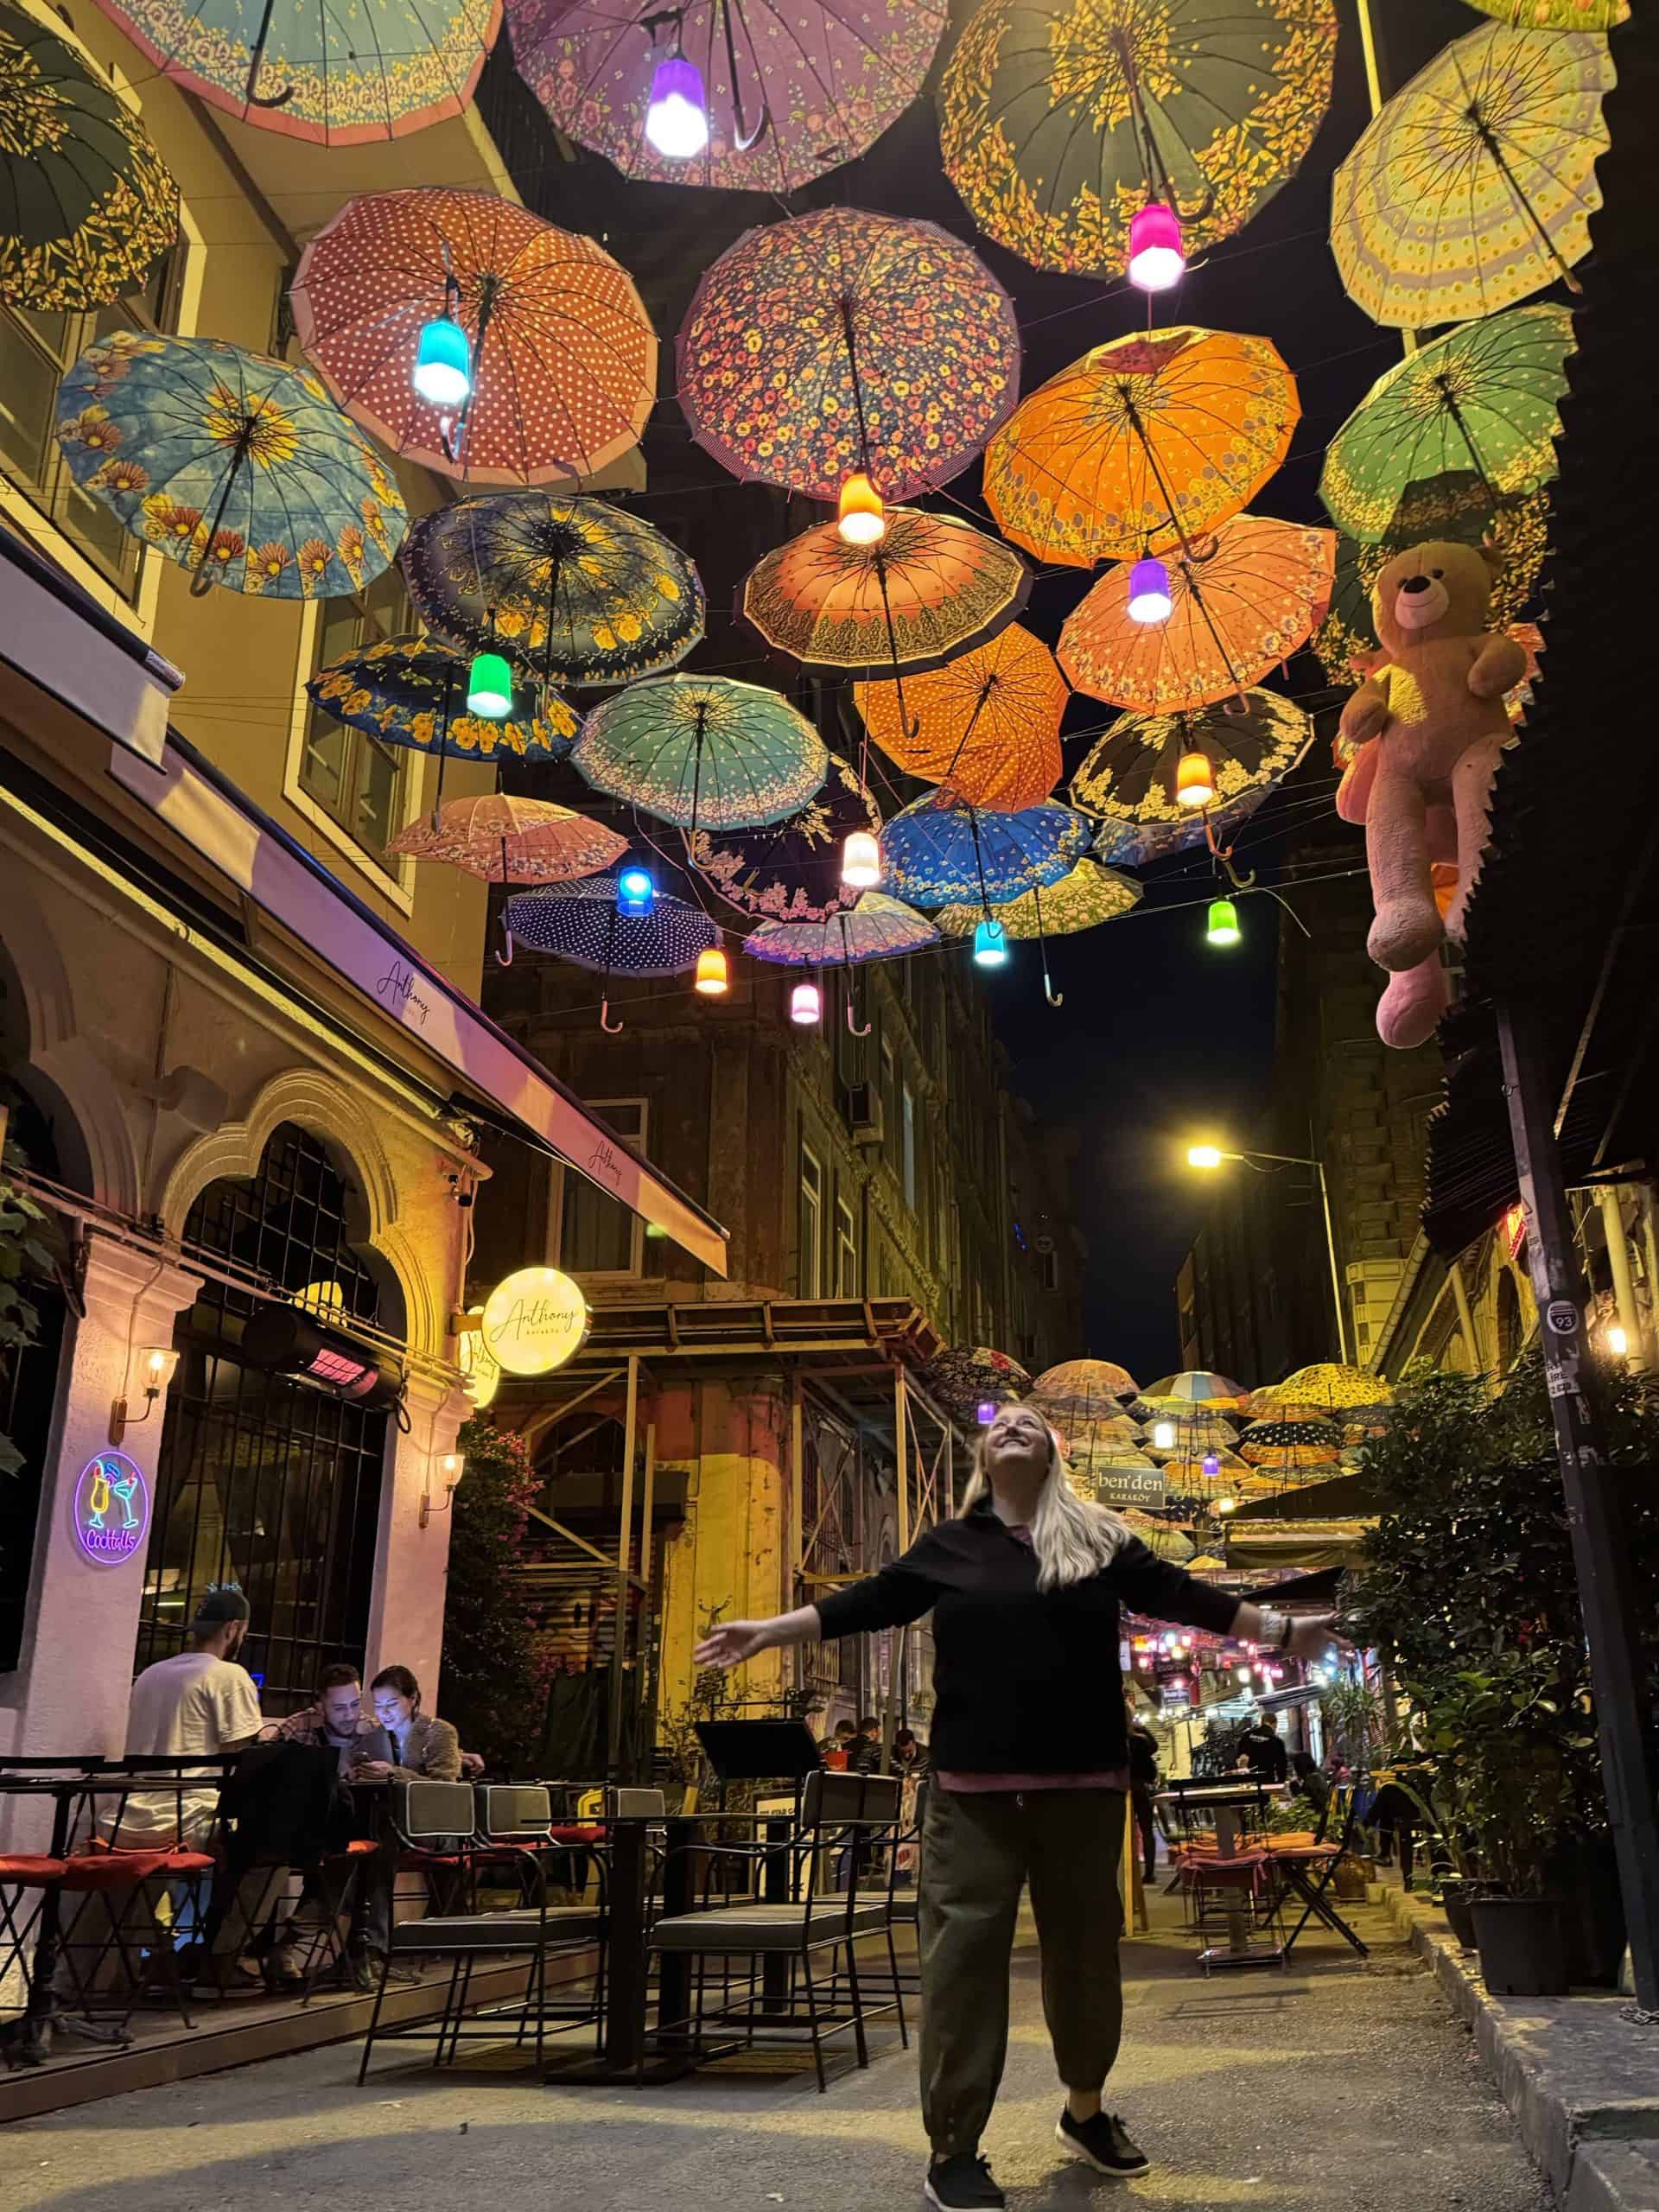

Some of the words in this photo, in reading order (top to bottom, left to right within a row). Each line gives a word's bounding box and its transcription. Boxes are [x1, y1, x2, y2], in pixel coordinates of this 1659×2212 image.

[377, 960, 430, 1025] Anthony
[489, 1299, 576, 1342] Anthony
[1554, 1316, 1573, 1328] 93
[86, 1529, 137, 1550] Cocktails
